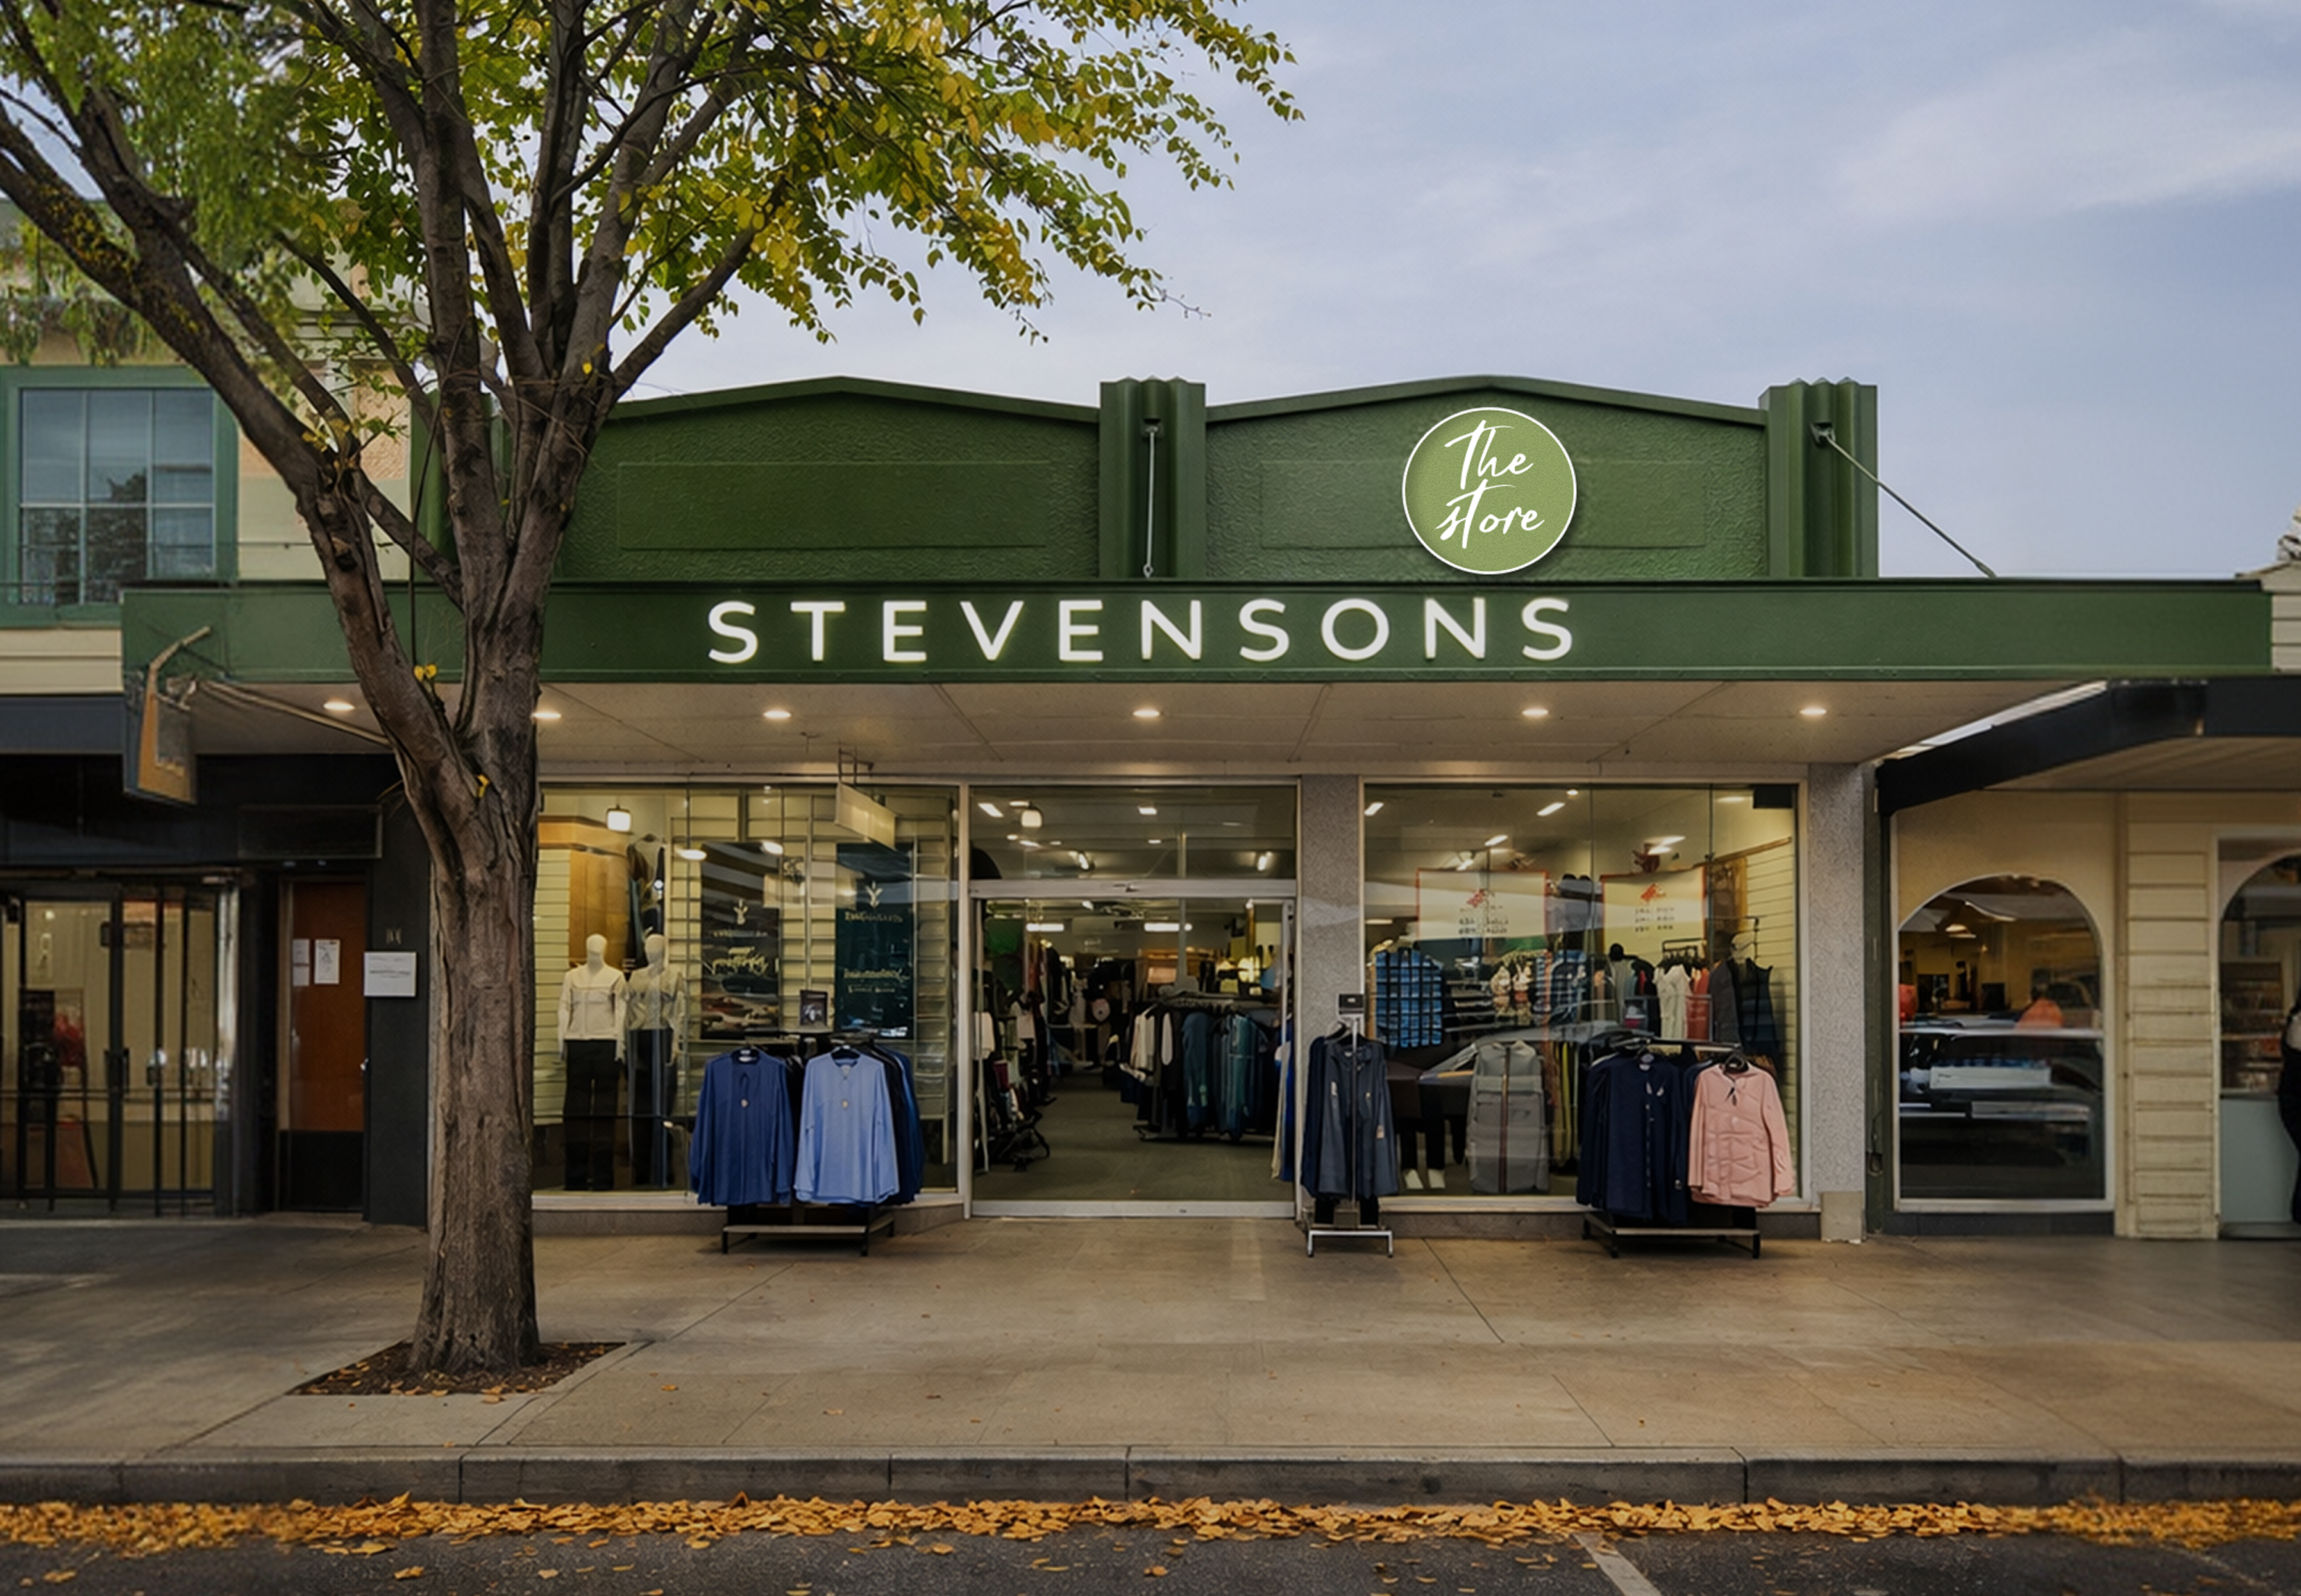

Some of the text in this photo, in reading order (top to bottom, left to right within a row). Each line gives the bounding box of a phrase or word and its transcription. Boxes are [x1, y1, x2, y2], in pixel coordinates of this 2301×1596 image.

[1444, 419, 1534, 490] The
[1435, 478, 1545, 549] store
[708, 598, 1572, 662] STEVENSONS
